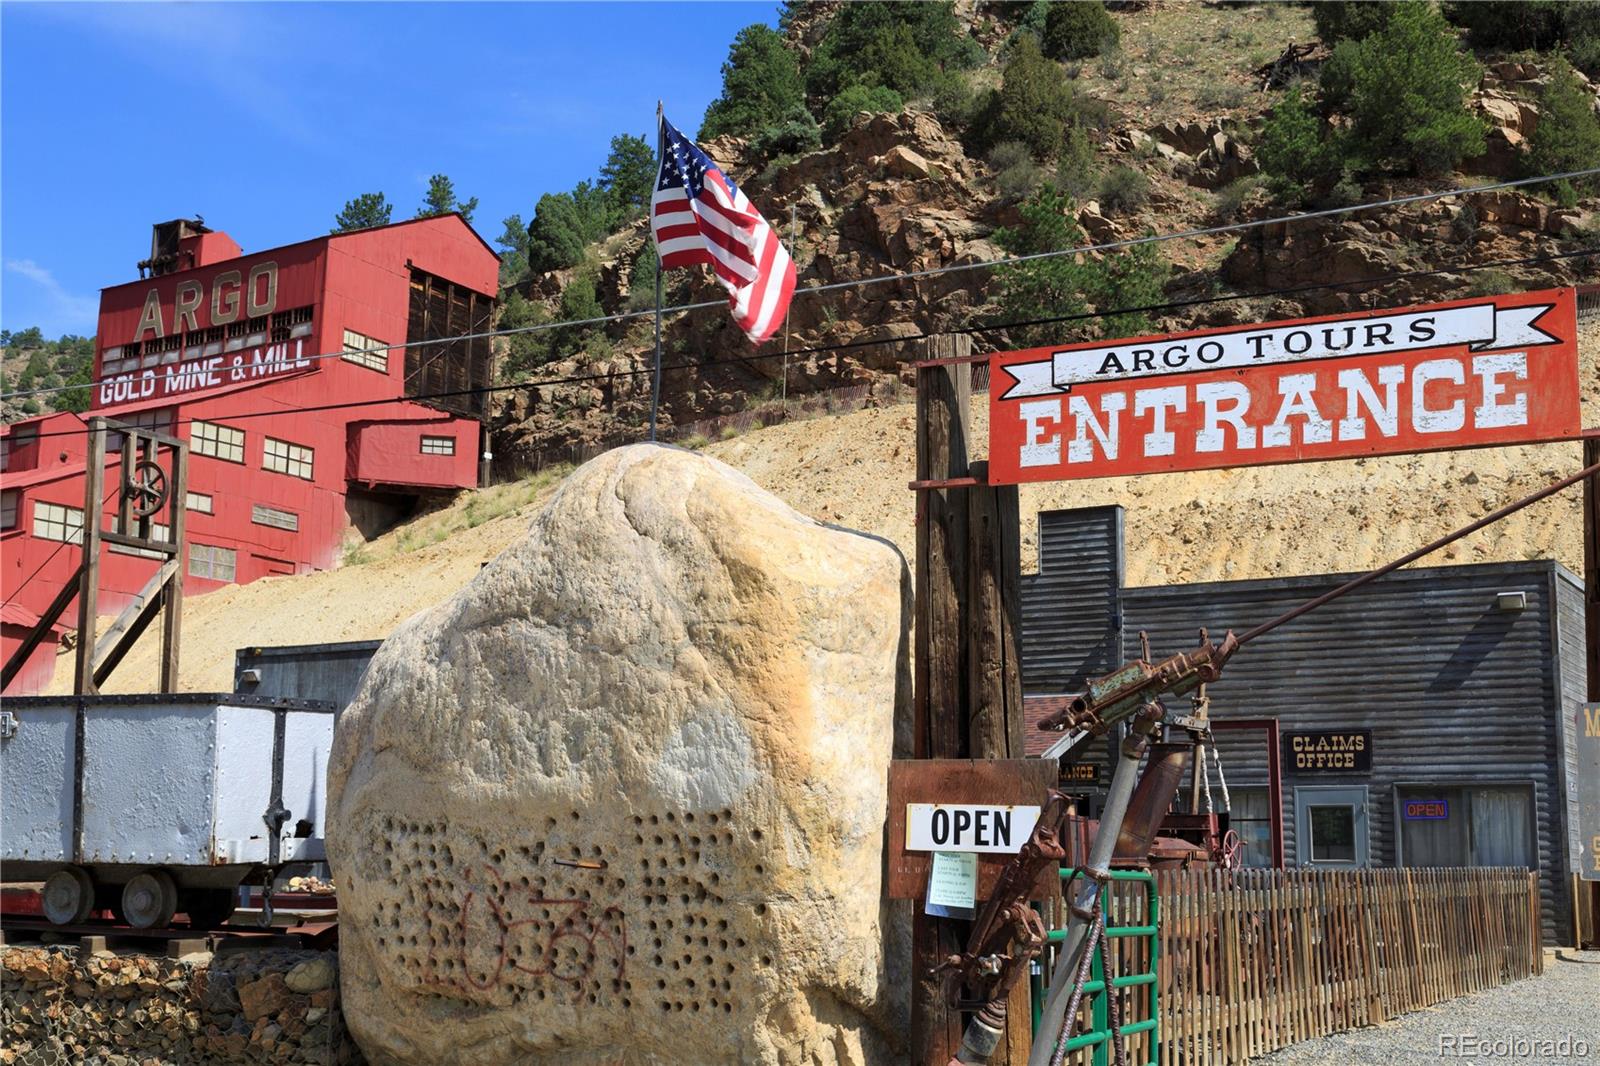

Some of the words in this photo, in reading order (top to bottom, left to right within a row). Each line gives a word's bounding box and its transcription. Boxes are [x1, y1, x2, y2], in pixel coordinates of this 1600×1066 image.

[134, 261, 278, 342] ARGO
[1096, 341, 1224, 375] ARGO
[1246, 317, 1436, 359] TOURS
[100, 370, 155, 404] GOLD
[165, 356, 223, 393] MINE
[231, 355, 246, 381] &
[252, 339, 310, 377] MILL
[1019, 352, 1528, 468] ENTRANCE
[1293, 736, 1365, 752] CLAIMS
[1296, 753, 1355, 768] OFFICE
[931, 809, 1011, 847] OPEN
[1407, 804, 1445, 816] OPEN
